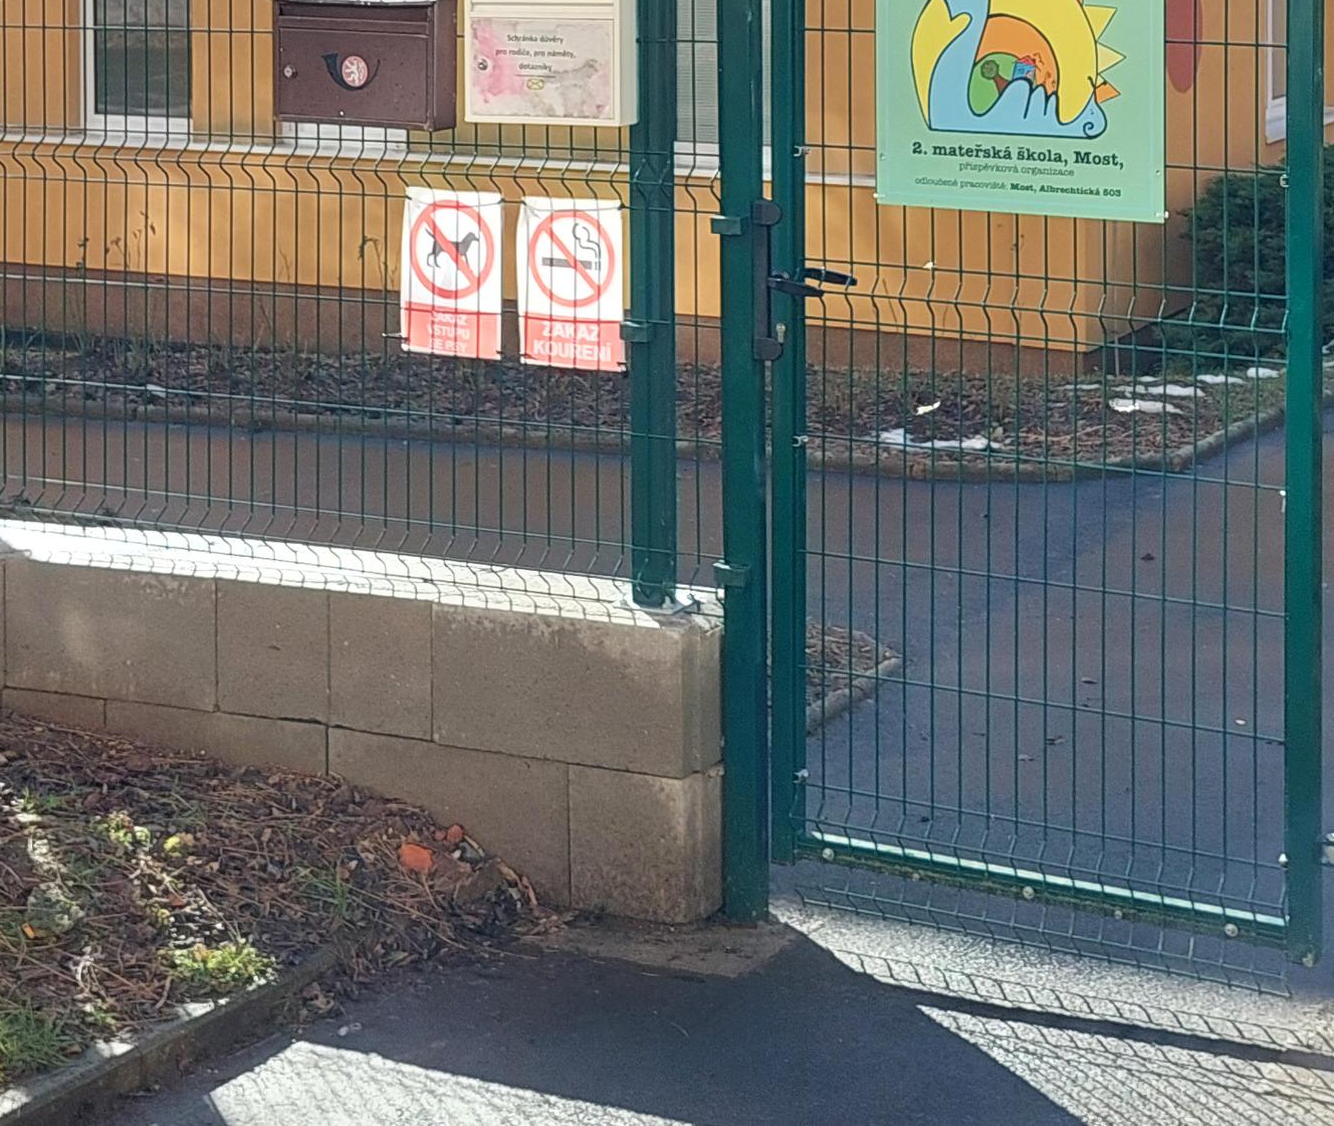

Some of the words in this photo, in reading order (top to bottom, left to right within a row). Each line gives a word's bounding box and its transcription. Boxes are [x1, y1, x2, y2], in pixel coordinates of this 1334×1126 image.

[495, 49, 508, 57] pro
[912, 141, 928, 155] 2.
[932, 143, 1013, 161] mateřská
[1016, 146, 1068, 167] škola,
[1073, 150, 1124, 170] Most,
[1020, 165, 1075, 177] organizace
[1010, 182, 1037, 194] Most,
[1039, 184, 1101, 196] Albrechtická
[1103, 188, 1122, 197] 503
